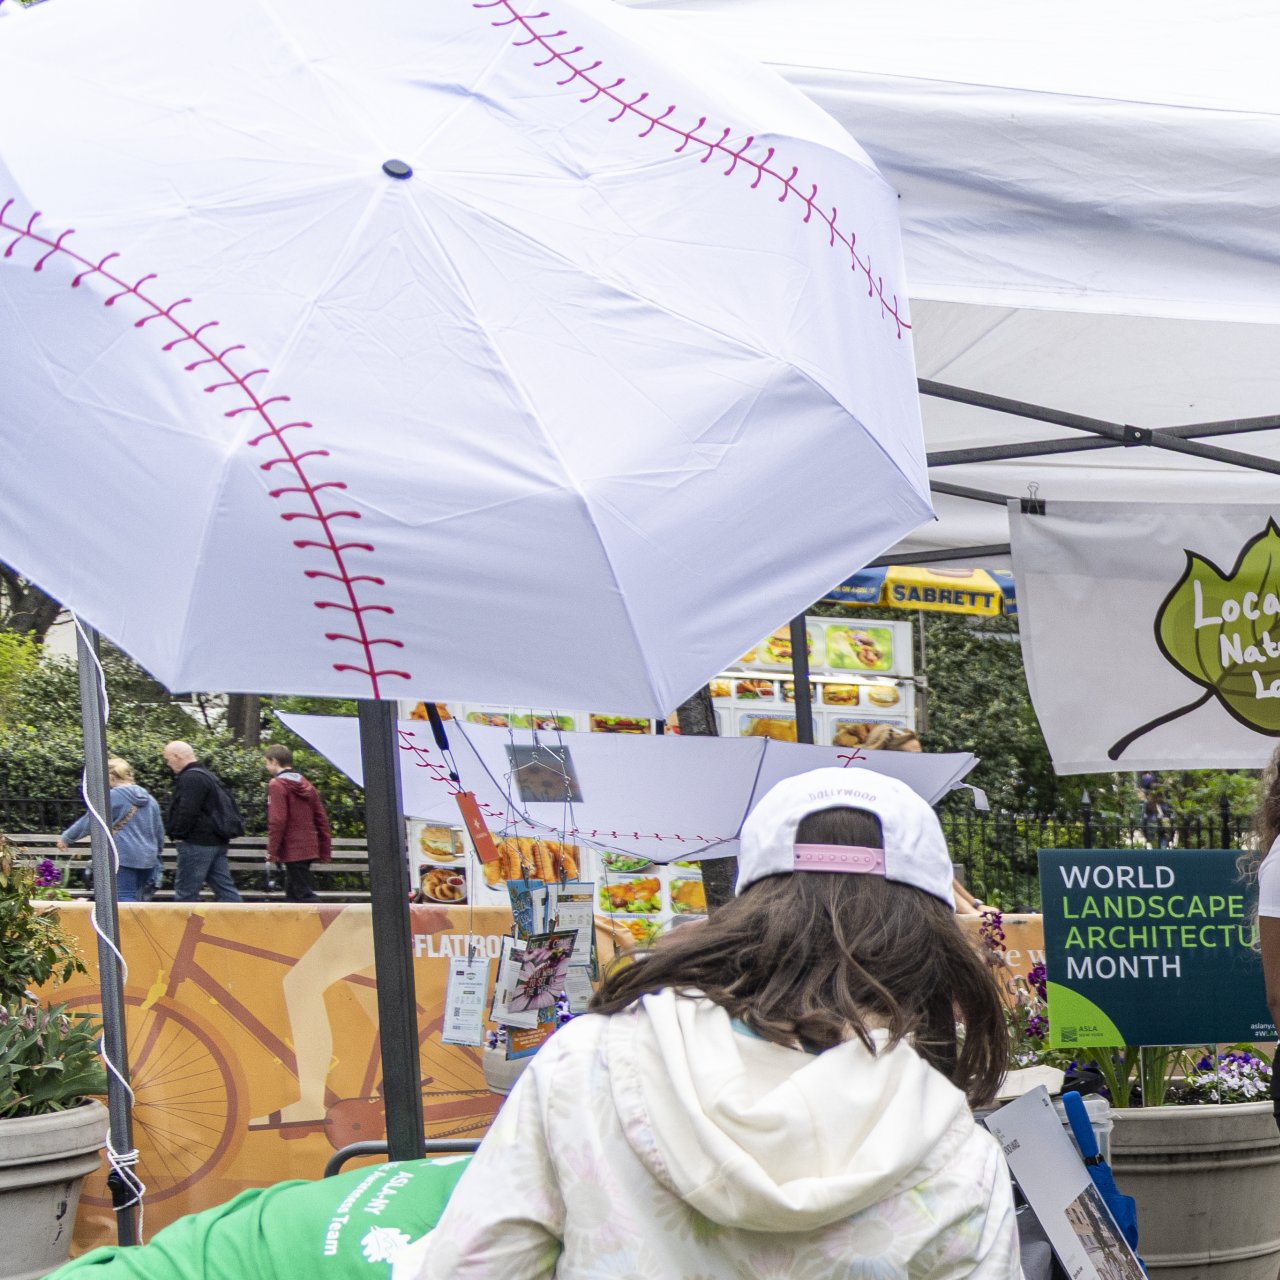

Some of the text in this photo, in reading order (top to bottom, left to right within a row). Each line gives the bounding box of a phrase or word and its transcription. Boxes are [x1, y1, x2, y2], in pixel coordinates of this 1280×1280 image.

[893, 584, 995, 608] SABRETT
[807, 788, 877, 802] DOLLYWOOD
[1059, 865, 1176, 890] WORLD
[1062, 895, 1245, 919] LANDSCAPE
[1066, 955, 1182, 980] MONTH
[364, 1170, 415, 1215] ASLA-NY
[323, 1215, 350, 1256] Team
